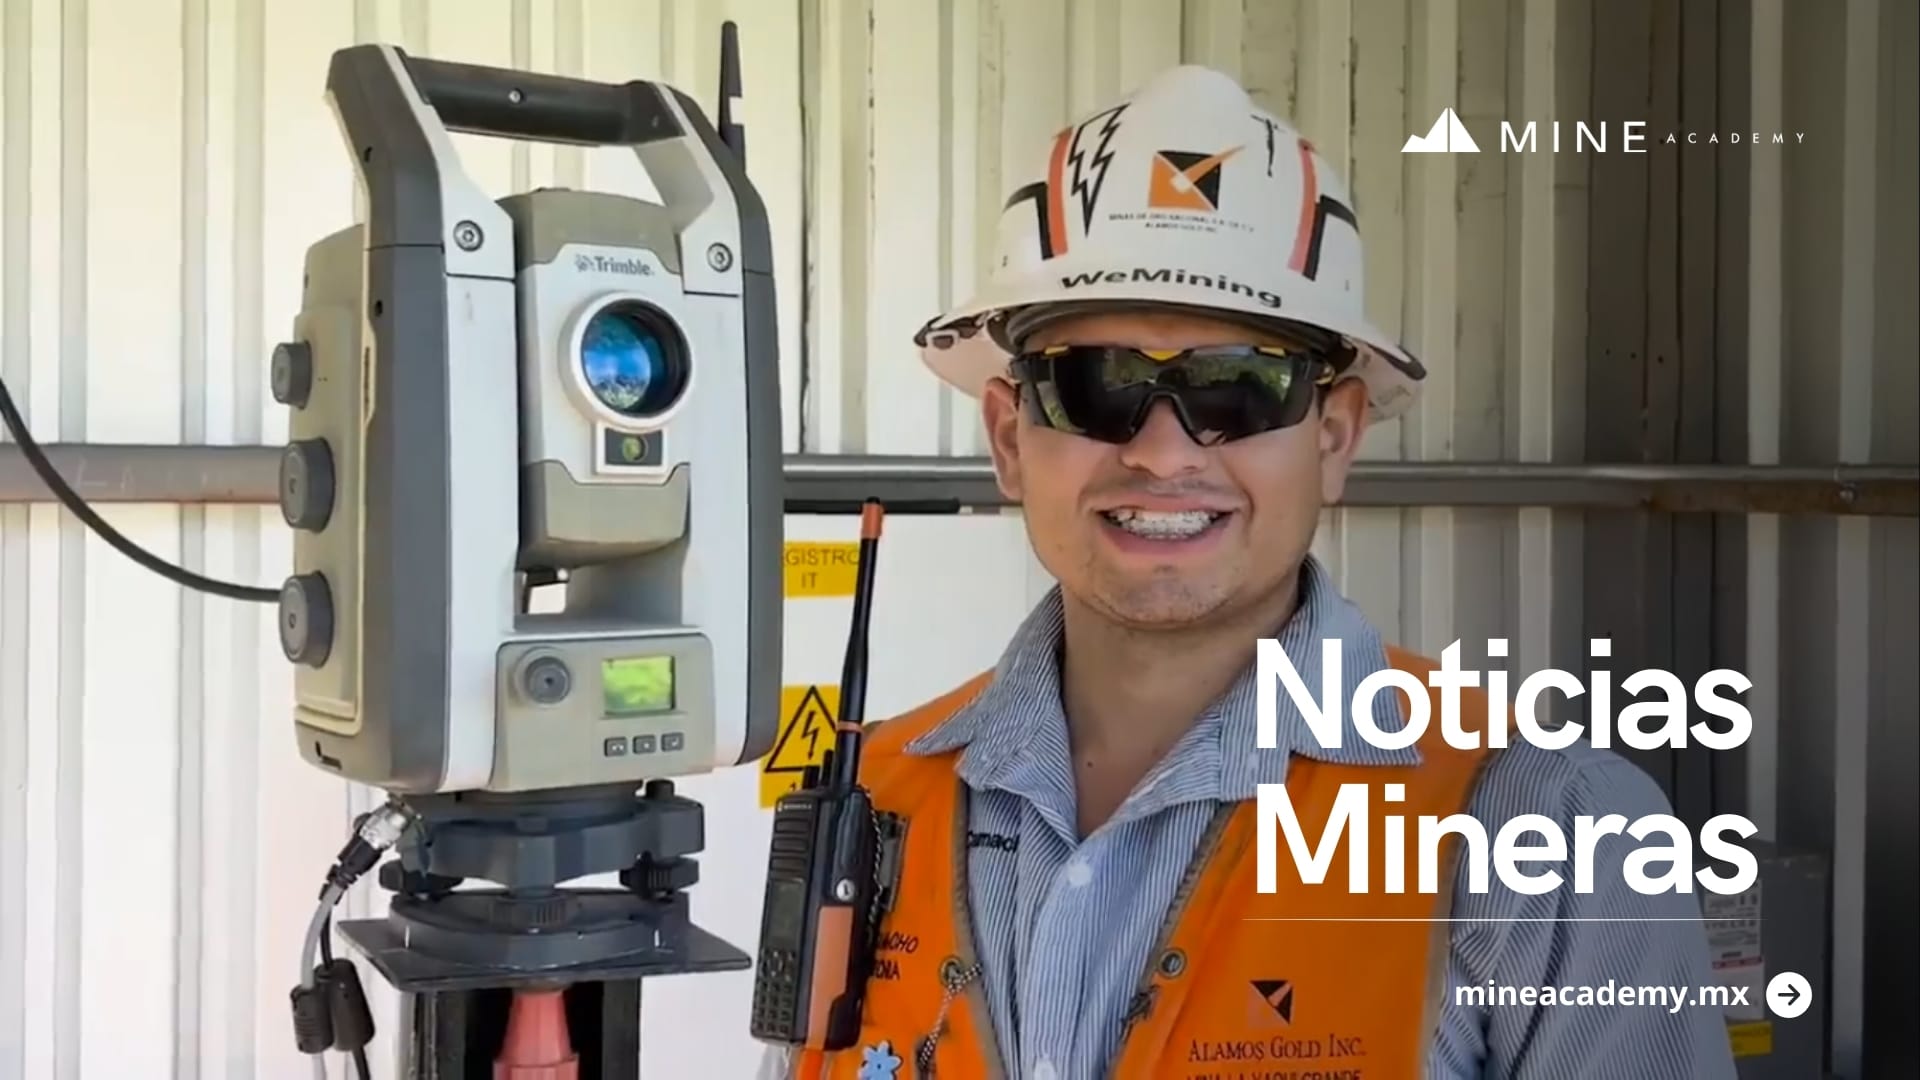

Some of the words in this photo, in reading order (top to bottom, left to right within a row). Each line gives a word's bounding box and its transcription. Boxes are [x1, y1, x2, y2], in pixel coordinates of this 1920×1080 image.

[594, 255, 652, 276] Trimble
[1061, 267, 1283, 309] WeMining
[783, 548, 859, 566] GISTRO
[801, 572, 818, 589] IT
[1188, 1038, 1265, 1063] ALAMOS
[1270, 1035, 1321, 1060] GOLD
